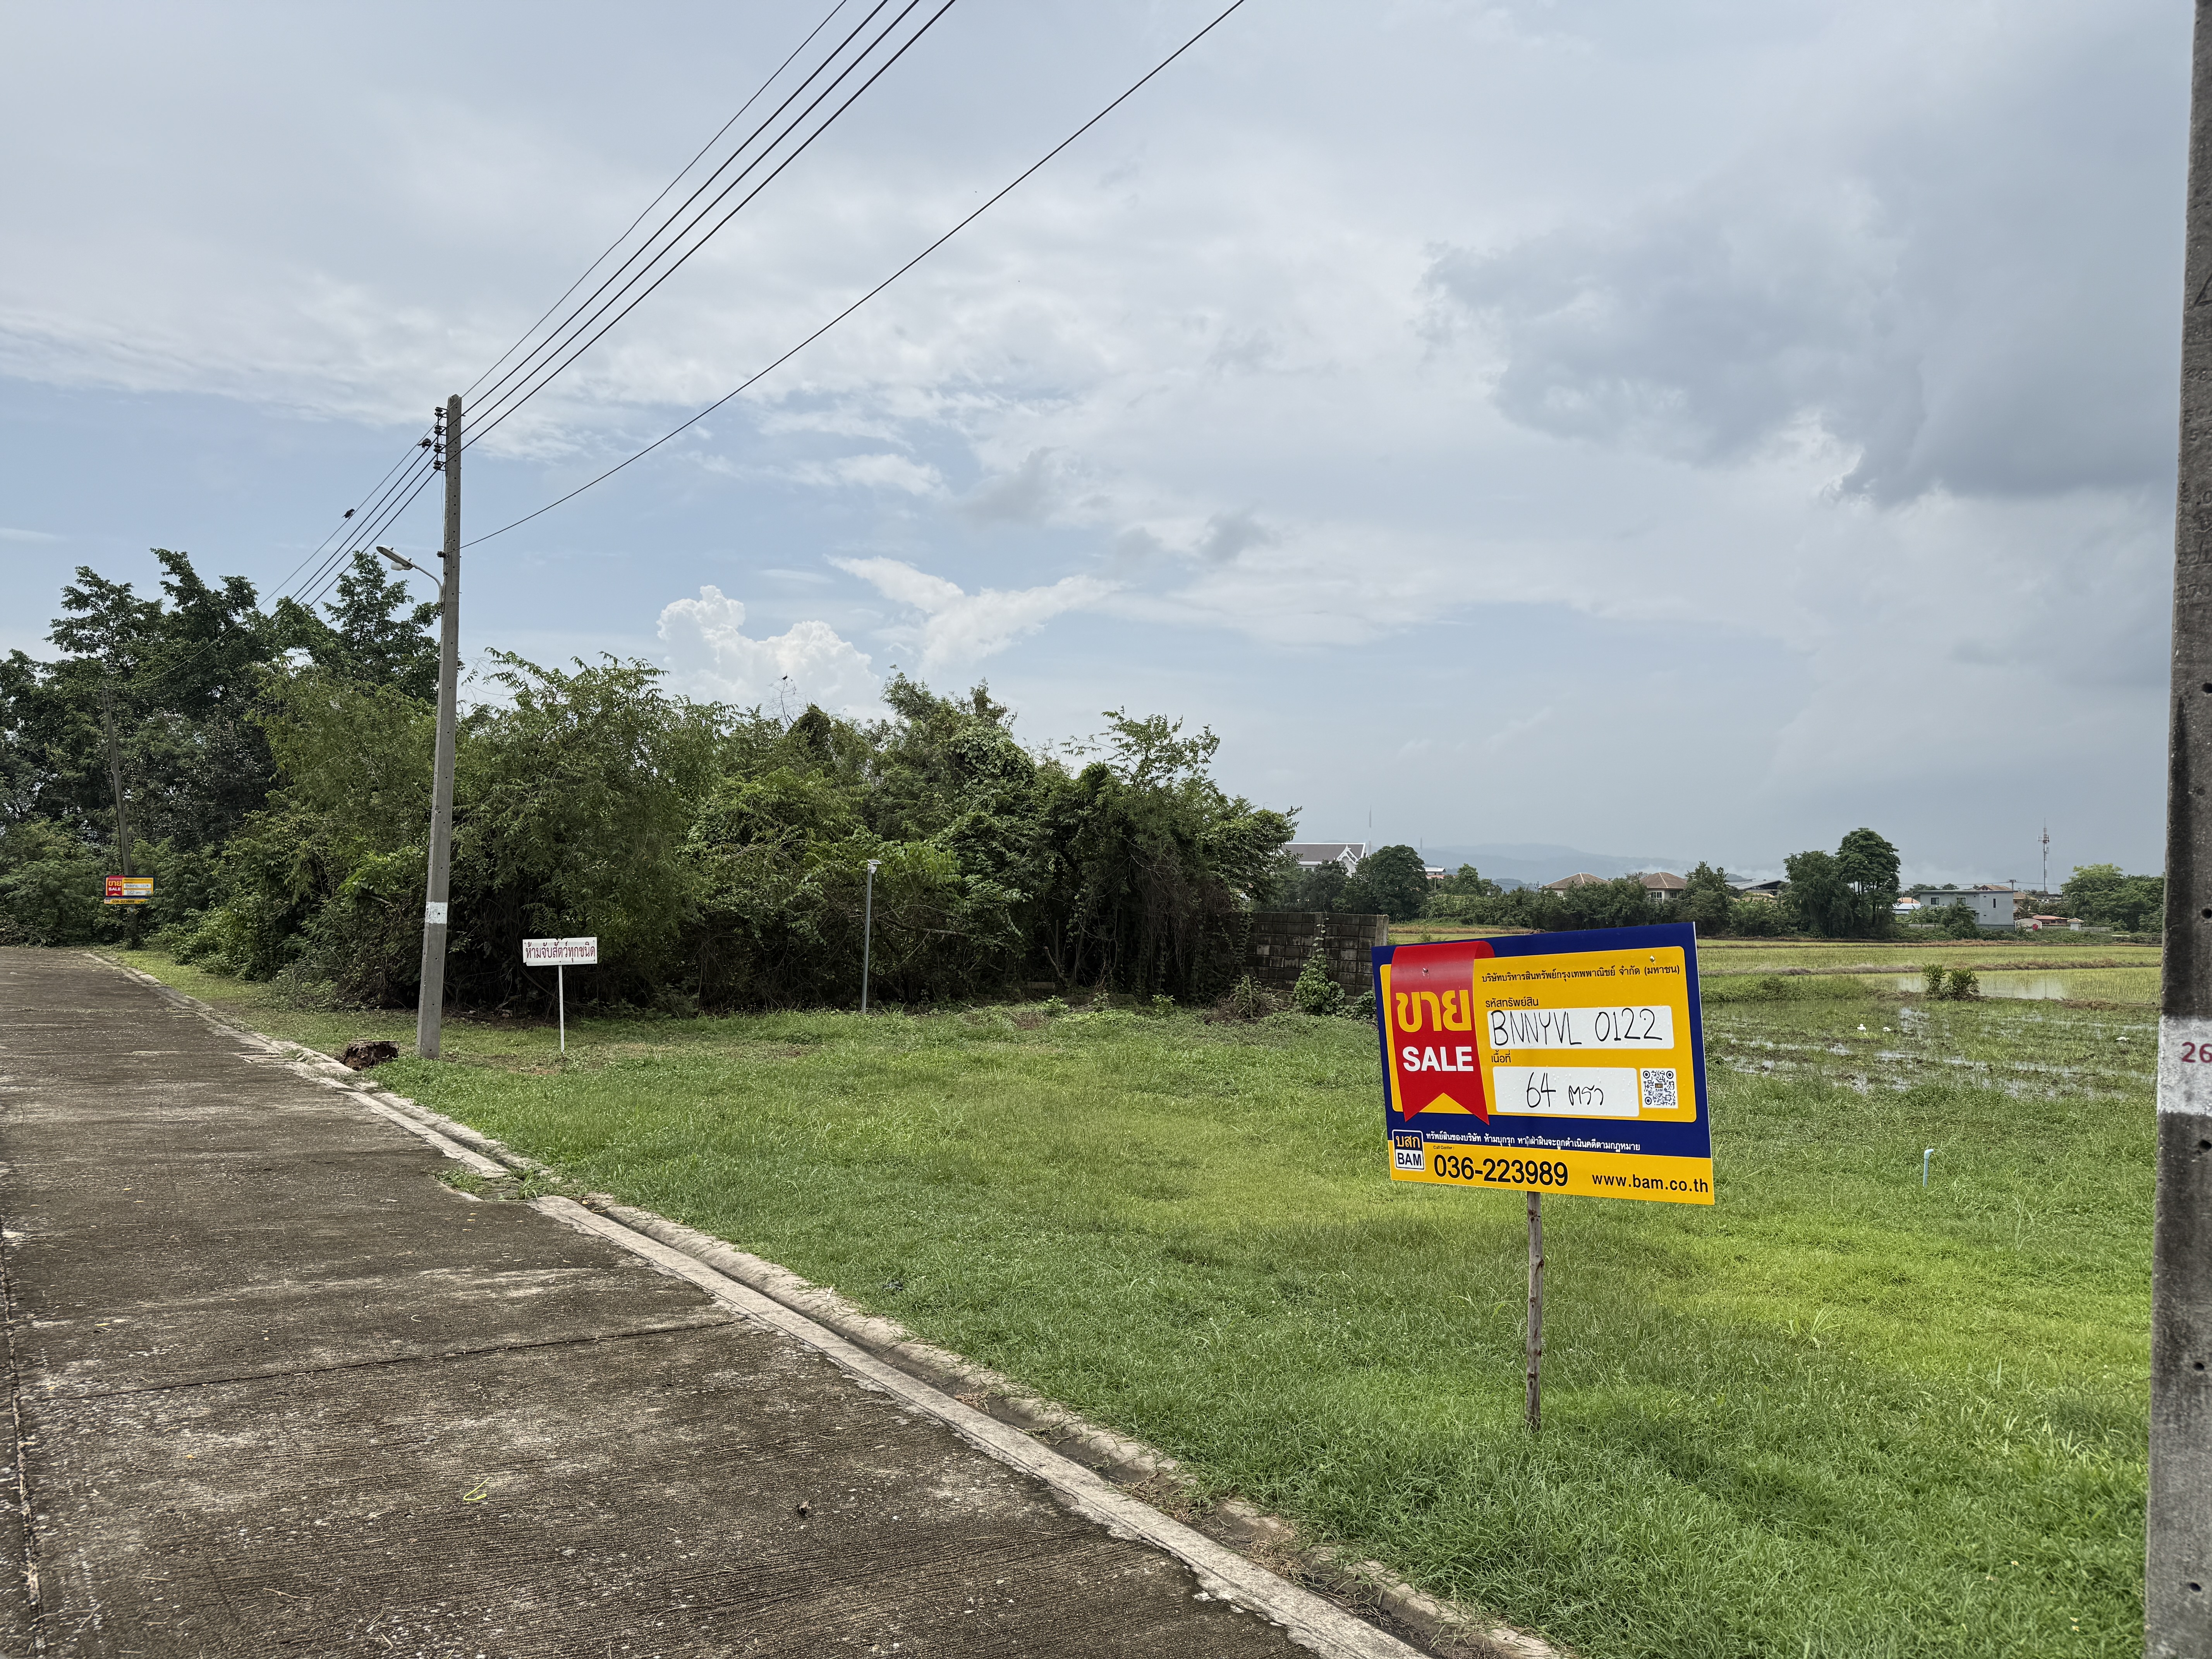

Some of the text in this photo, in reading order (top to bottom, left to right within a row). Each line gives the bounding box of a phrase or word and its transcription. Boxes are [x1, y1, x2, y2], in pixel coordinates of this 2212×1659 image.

[526, 941, 595, 963] ห้ามจับสัตว์ทุกชนิด
[1482, 965, 1680, 982] บริษัทบริหารสินทรัพย์กรุงเทพพาณิชย์ จำกัด (มหาชน)
[1395, 989, 1472, 1033] ขาย
[1486, 996, 1539, 1007] รหัสทรัพย์สิน
[1491, 1008, 1662, 1046] BNNYVL 0122
[1402, 1046, 1474, 1072] SALE
[1491, 1050, 1511, 1063] เนื้อที่
[1526, 1072, 1556, 1108] 64
[1396, 1135, 1420, 1148] บสก
[1426, 1130, 1482, 1142] ทรัพย์สินของบริษัท
[1484, 1133, 1515, 1147] ห้ามบุกรุก
[1397, 1152, 1422, 1166] BAM
[1434, 1154, 1568, 1187] 036-223989
[1592, 1174, 1709, 1193] www.bam.co.th
